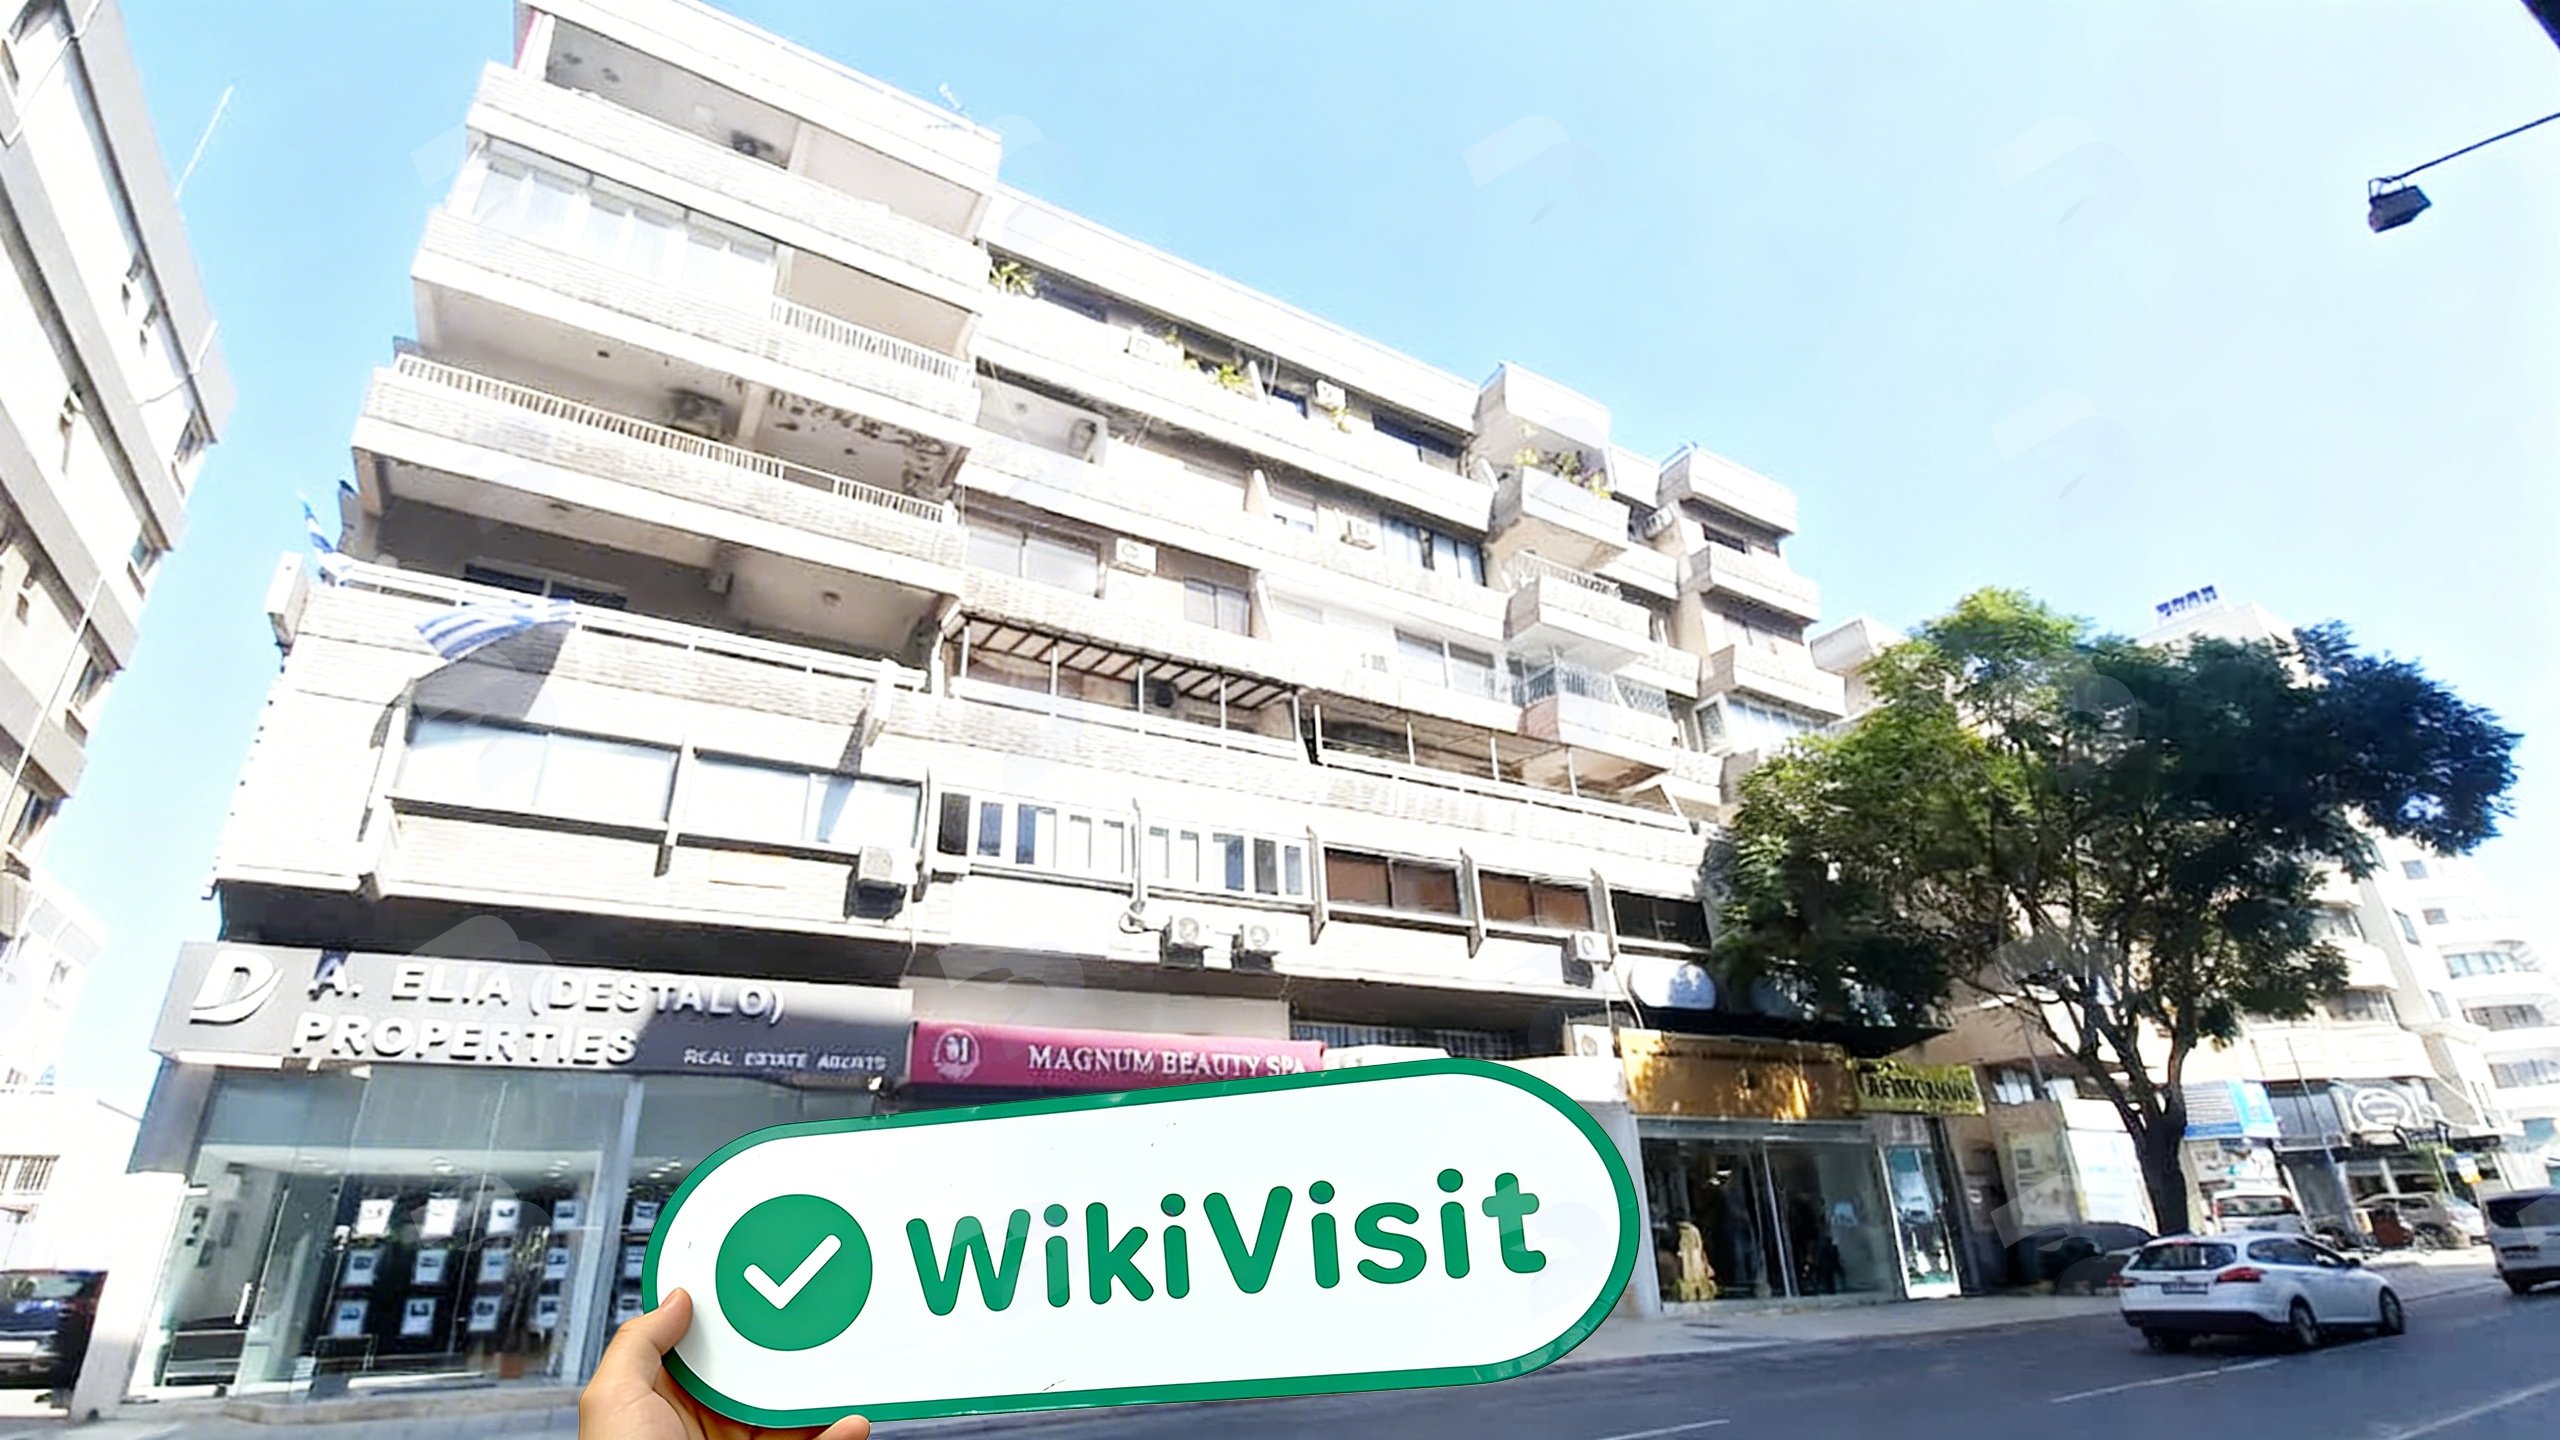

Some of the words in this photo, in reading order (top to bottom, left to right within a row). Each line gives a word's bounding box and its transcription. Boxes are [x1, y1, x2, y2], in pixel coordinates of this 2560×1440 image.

[305, 956, 364, 1001] A.
[391, 962, 510, 1006] ELIA
[528, 971, 786, 1025] (DESTALO)
[292, 1010, 638, 1067] PROPERTIES
[684, 1047, 735, 1067] REAL
[1028, 1044, 1155, 1074] MAGNUM
[1161, 1050, 1263, 1077] BEAUTY
[1267, 1056, 1307, 1076] SPA
